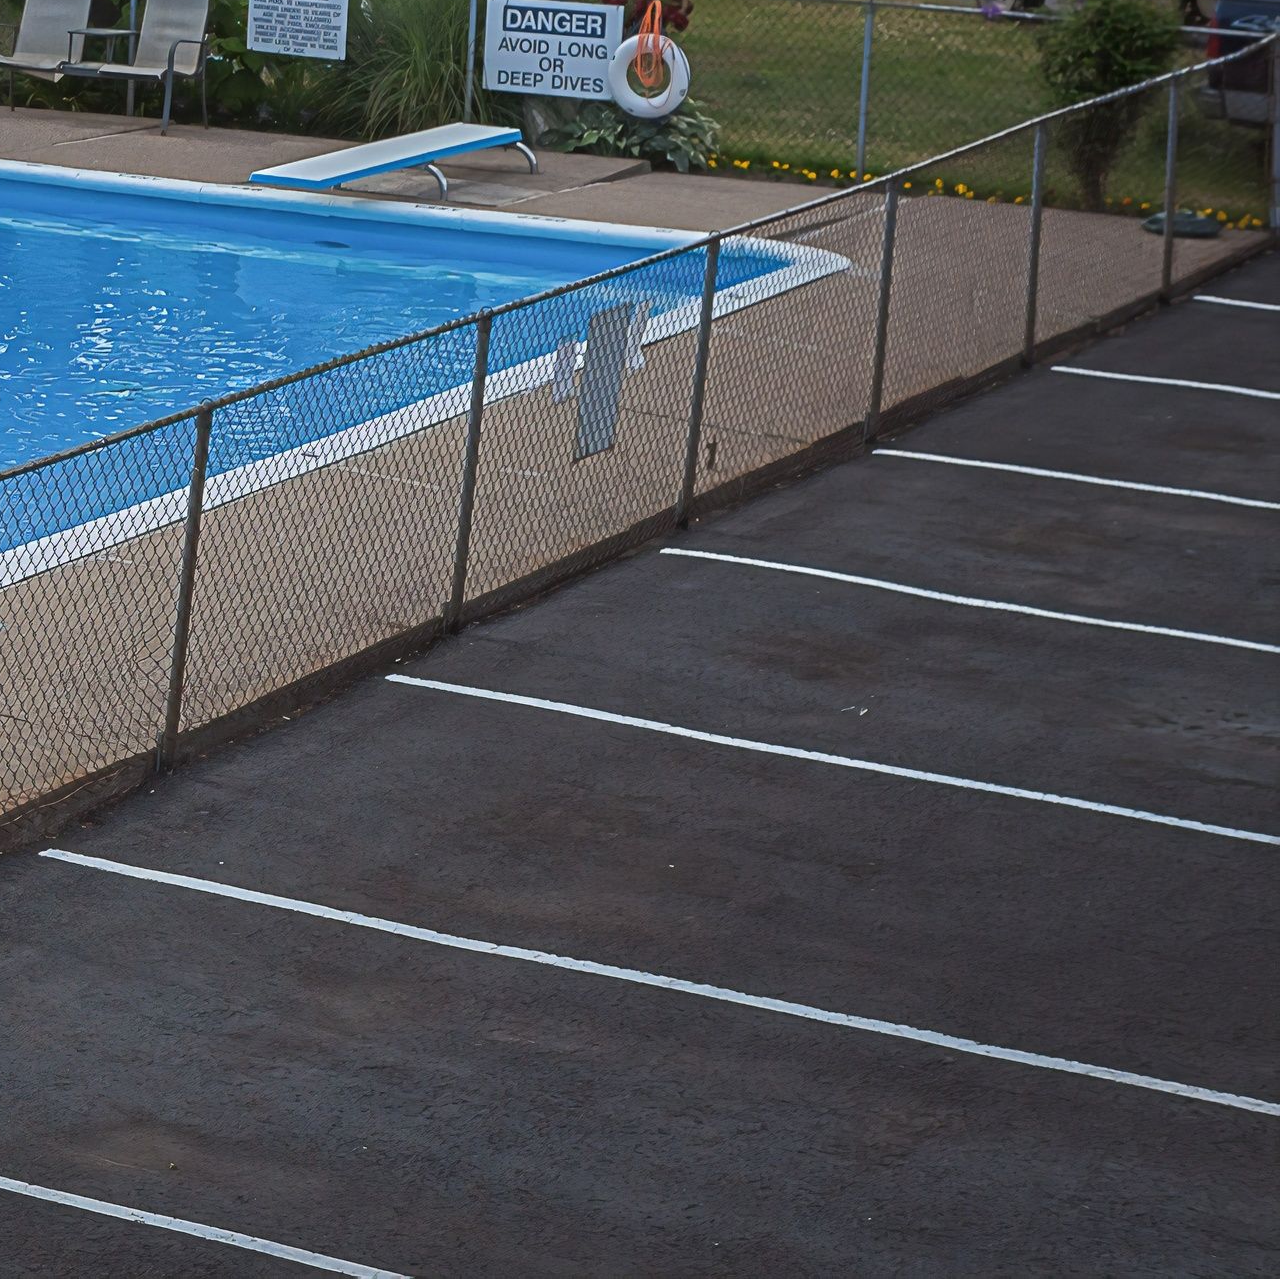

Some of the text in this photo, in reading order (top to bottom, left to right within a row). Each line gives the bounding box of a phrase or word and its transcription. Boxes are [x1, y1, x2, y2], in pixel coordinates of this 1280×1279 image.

[505, 8, 603, 35] DANGER
[498, 36, 608, 59] AVOID LONG
[539, 56, 564, 73] OR
[497, 70, 604, 93] DEEP DIVES
